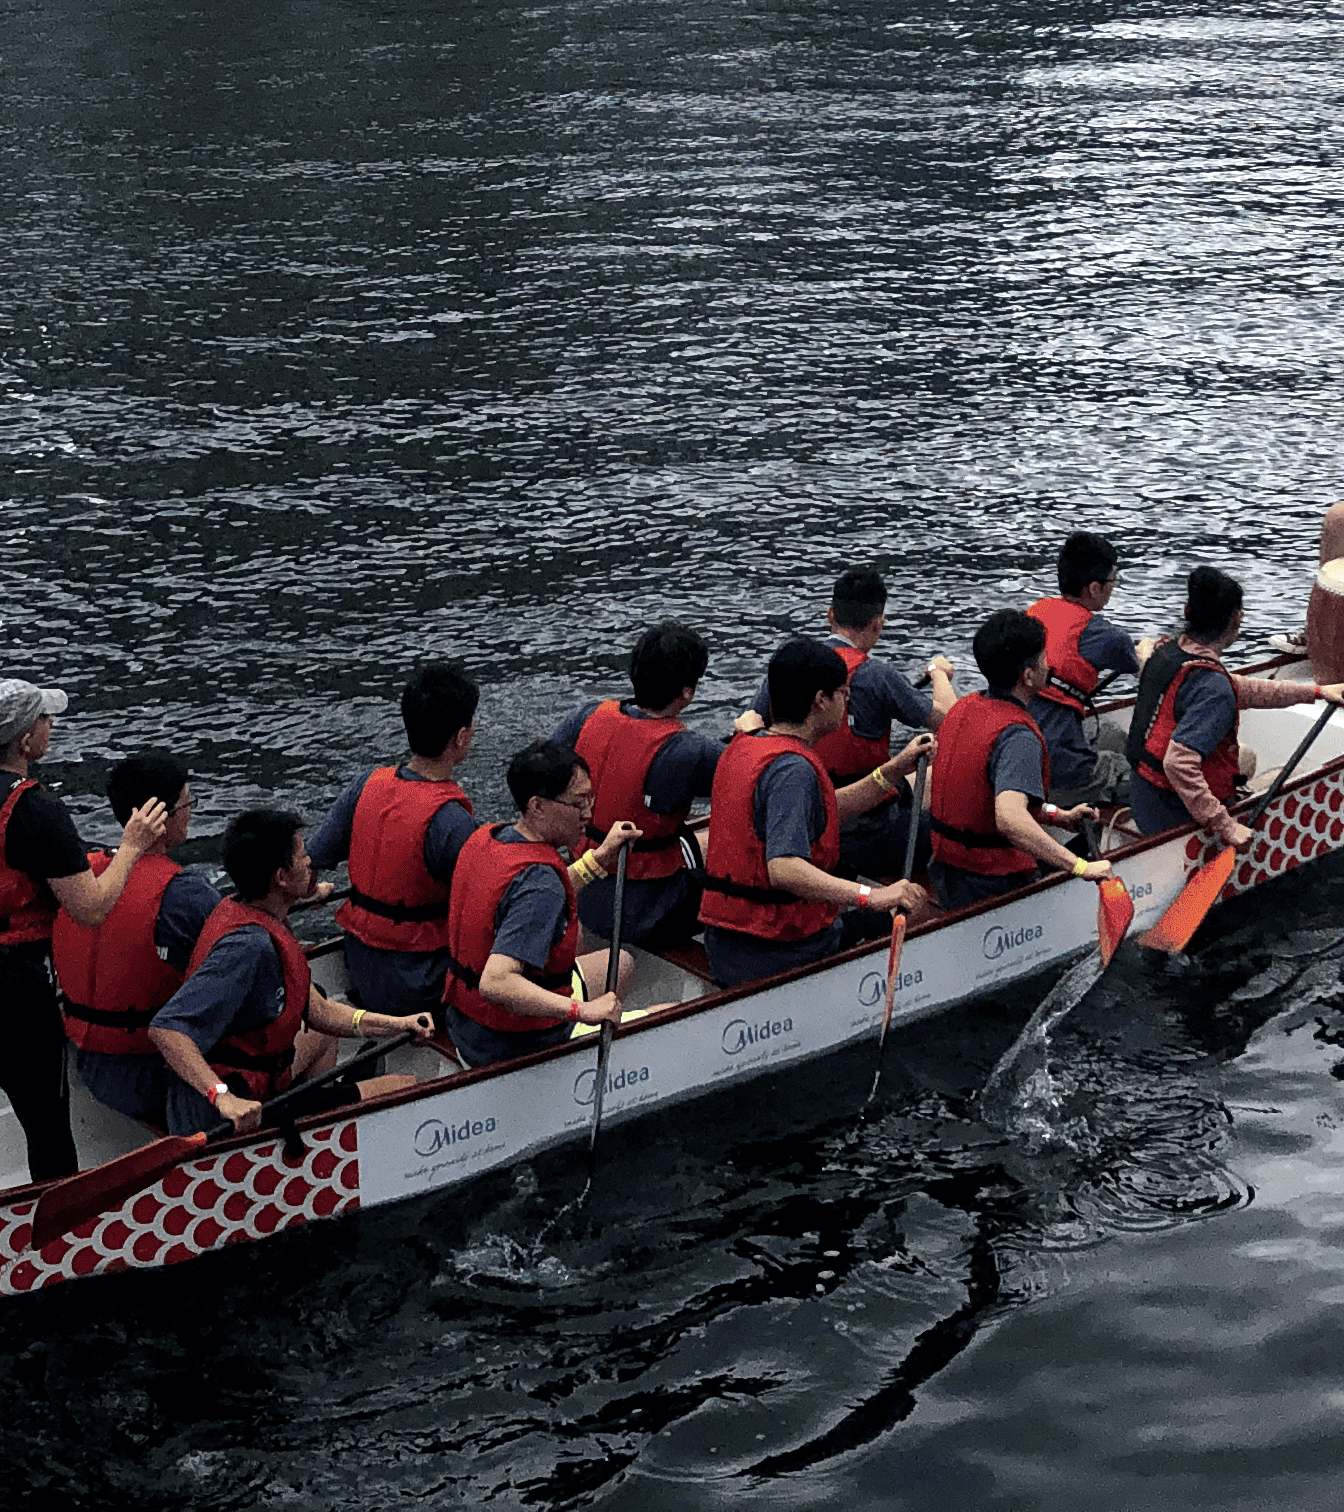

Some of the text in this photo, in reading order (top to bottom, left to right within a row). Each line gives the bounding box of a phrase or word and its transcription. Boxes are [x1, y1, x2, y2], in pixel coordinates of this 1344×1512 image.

[983, 925, 1043, 960] Midea
[858, 969, 923, 1006] Mdea
[721, 1017, 793, 1056] Midea
[414, 1117, 496, 1157] Midea
